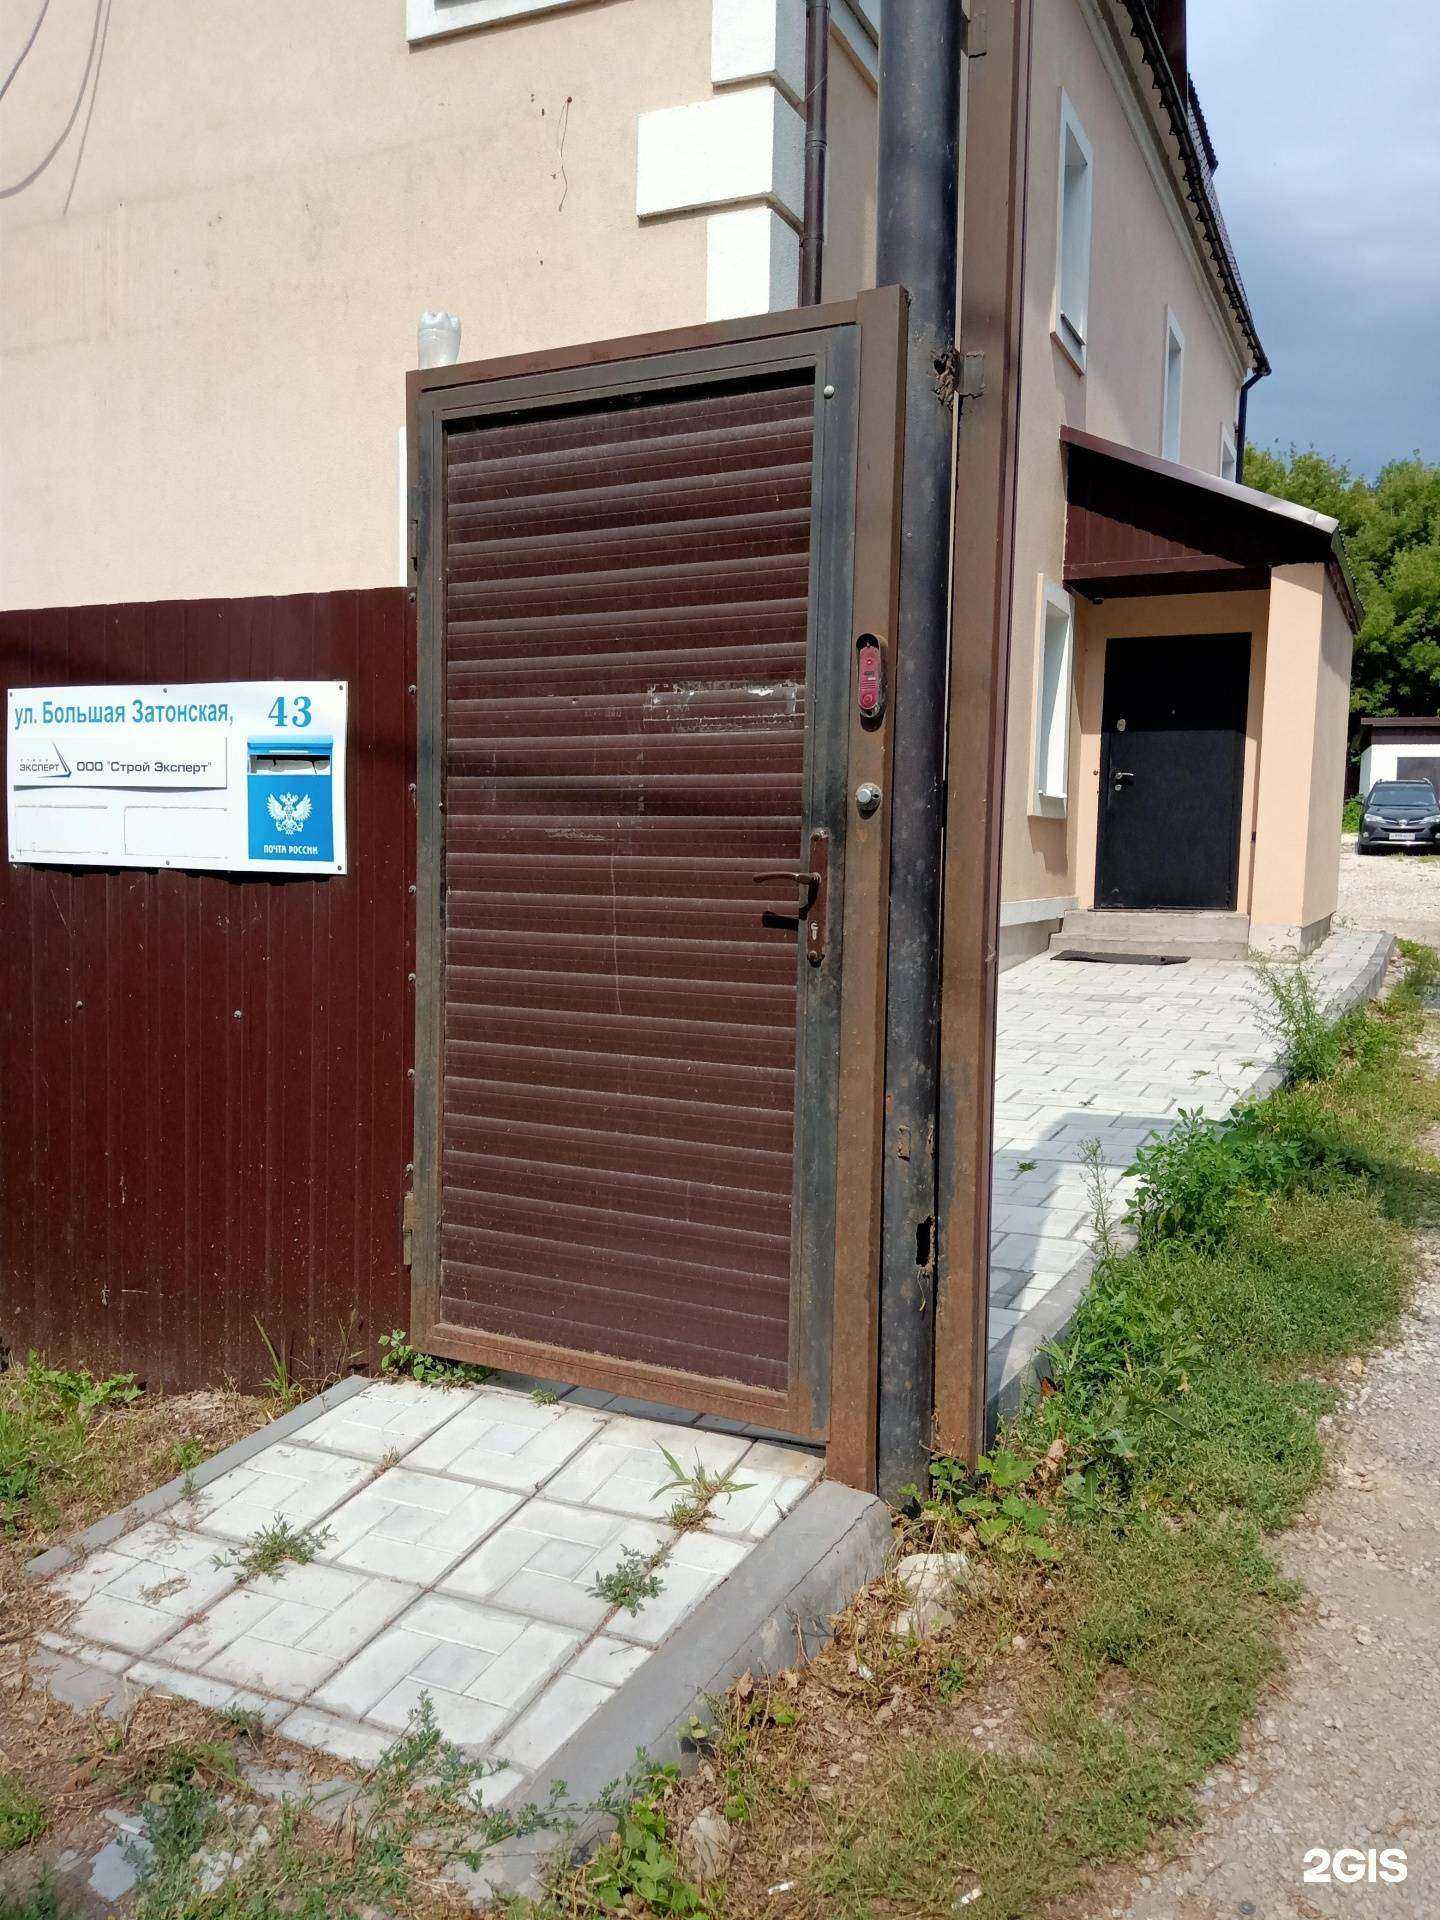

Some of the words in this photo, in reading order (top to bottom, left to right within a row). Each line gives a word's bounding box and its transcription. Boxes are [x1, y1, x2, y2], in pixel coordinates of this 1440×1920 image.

[14, 706, 38, 730] ул.
[42, 700, 126, 724] Большая
[132, 698, 234, 726] Затонская,
[267, 695, 313, 728] 43
[19, 763, 60, 772] ЭКСПЕРТ
[76, 761, 104, 772] ООО
[107, 761, 150, 774] "Строй
[154, 761, 212, 774] Эксперт"
[263, 844, 287, 854] ПОЧТА
[288, 845, 319, 855] РОССИИ
